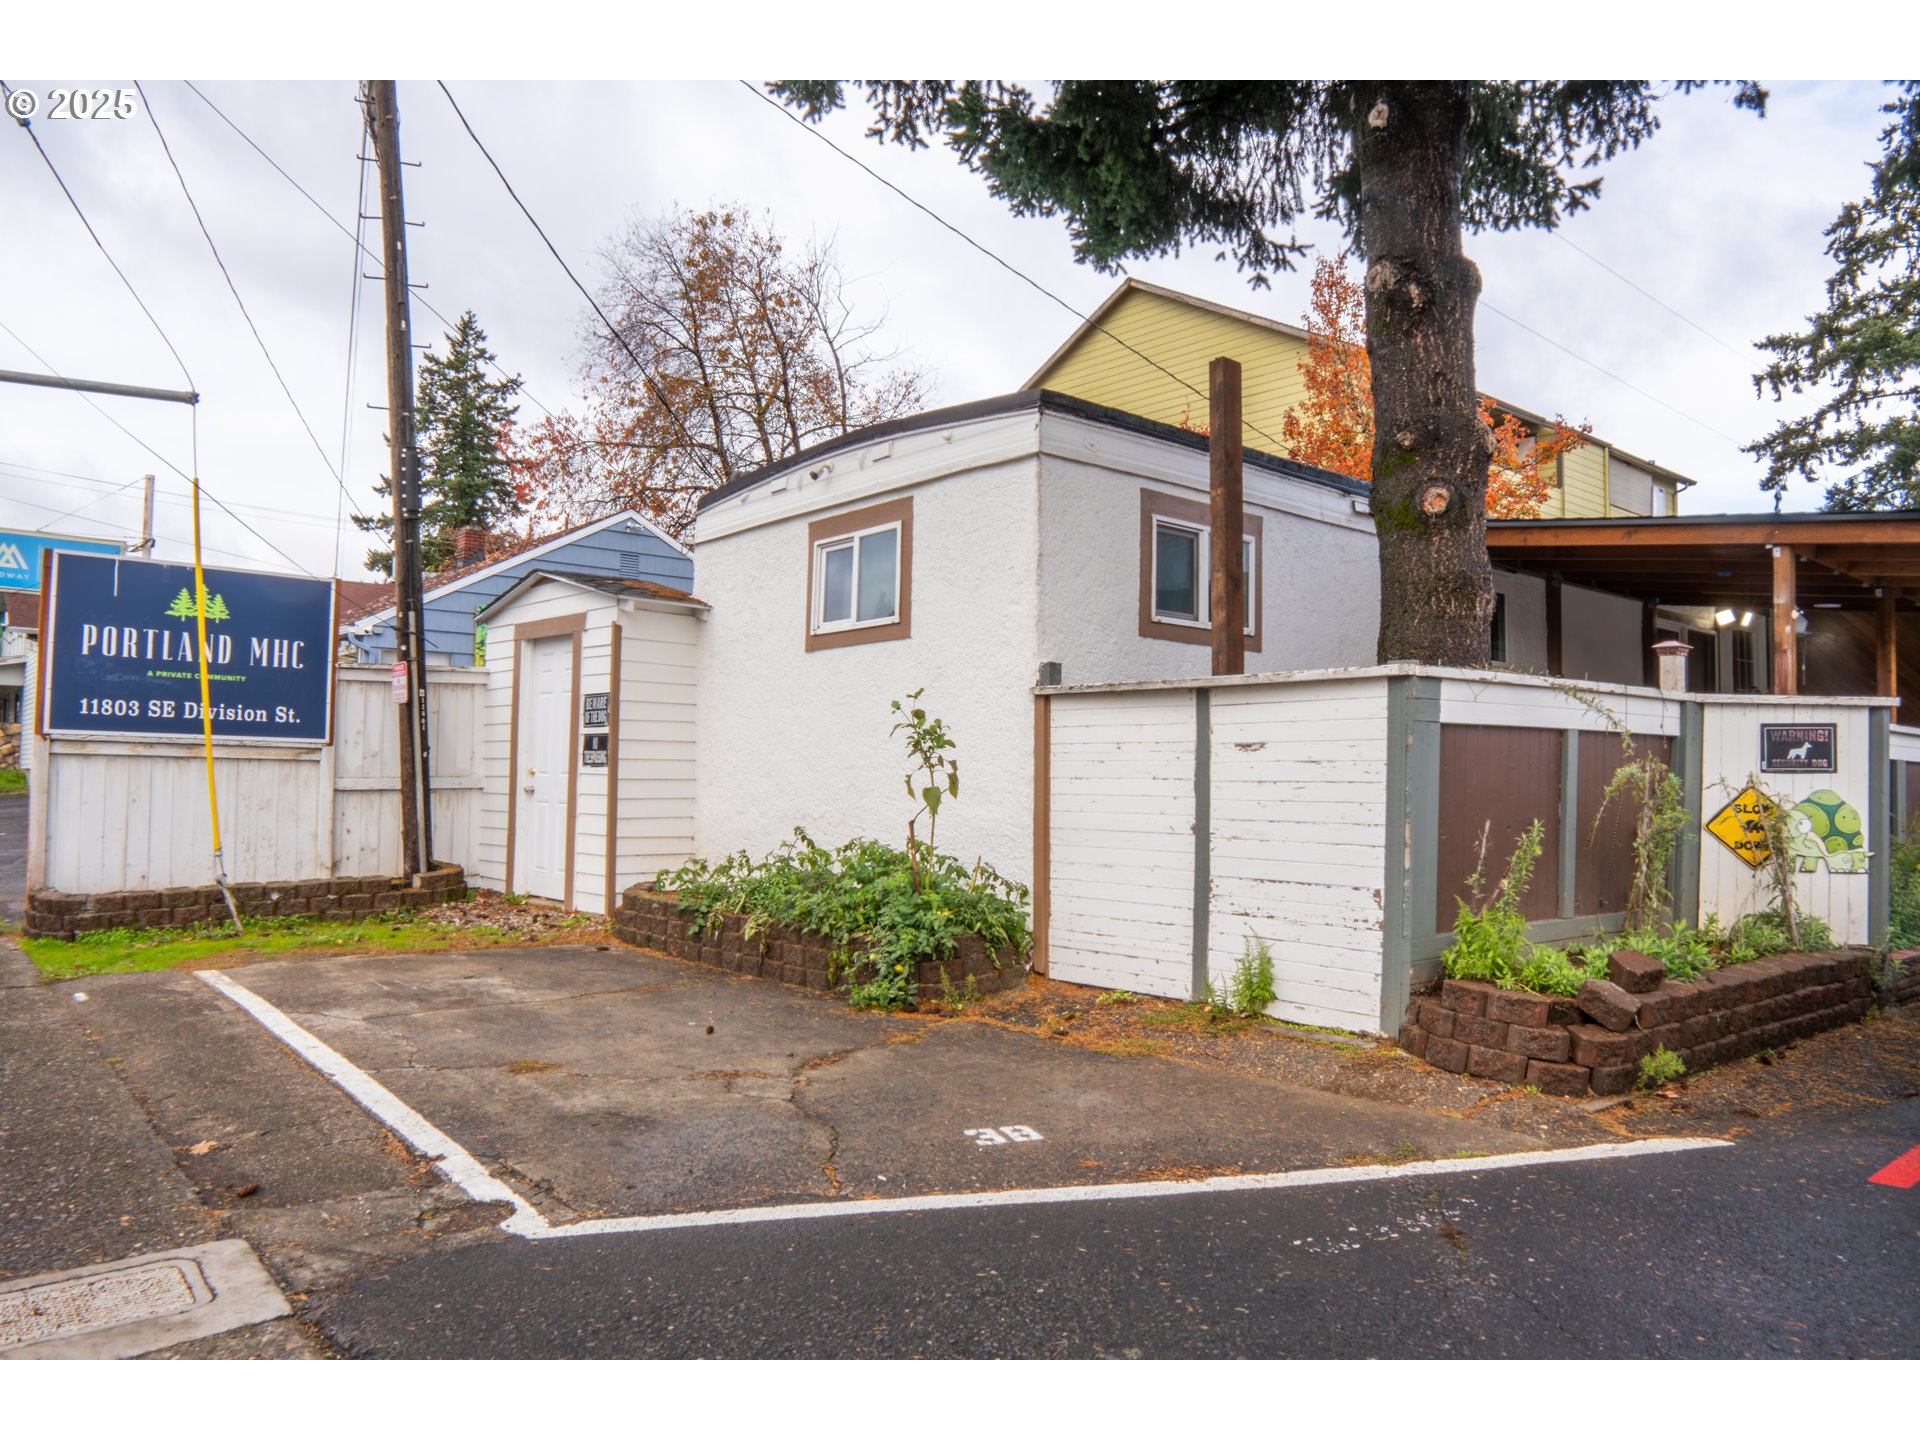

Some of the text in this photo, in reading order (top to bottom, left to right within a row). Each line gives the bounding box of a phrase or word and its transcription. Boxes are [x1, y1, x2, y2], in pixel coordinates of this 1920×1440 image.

[250, 637, 304, 669] MHC
[156, 671, 192, 679] PRIVATE
[194, 674, 247, 682] CMMUNITY
[80, 698, 139, 716] 11803
[148, 700, 175, 717] SE
[275, 706, 301, 723] St.
[1770, 730, 1828, 742] WARNING!
[1771, 759, 1828, 767] SECURITY DOG
[964, 1125, 1044, 1145] 38
